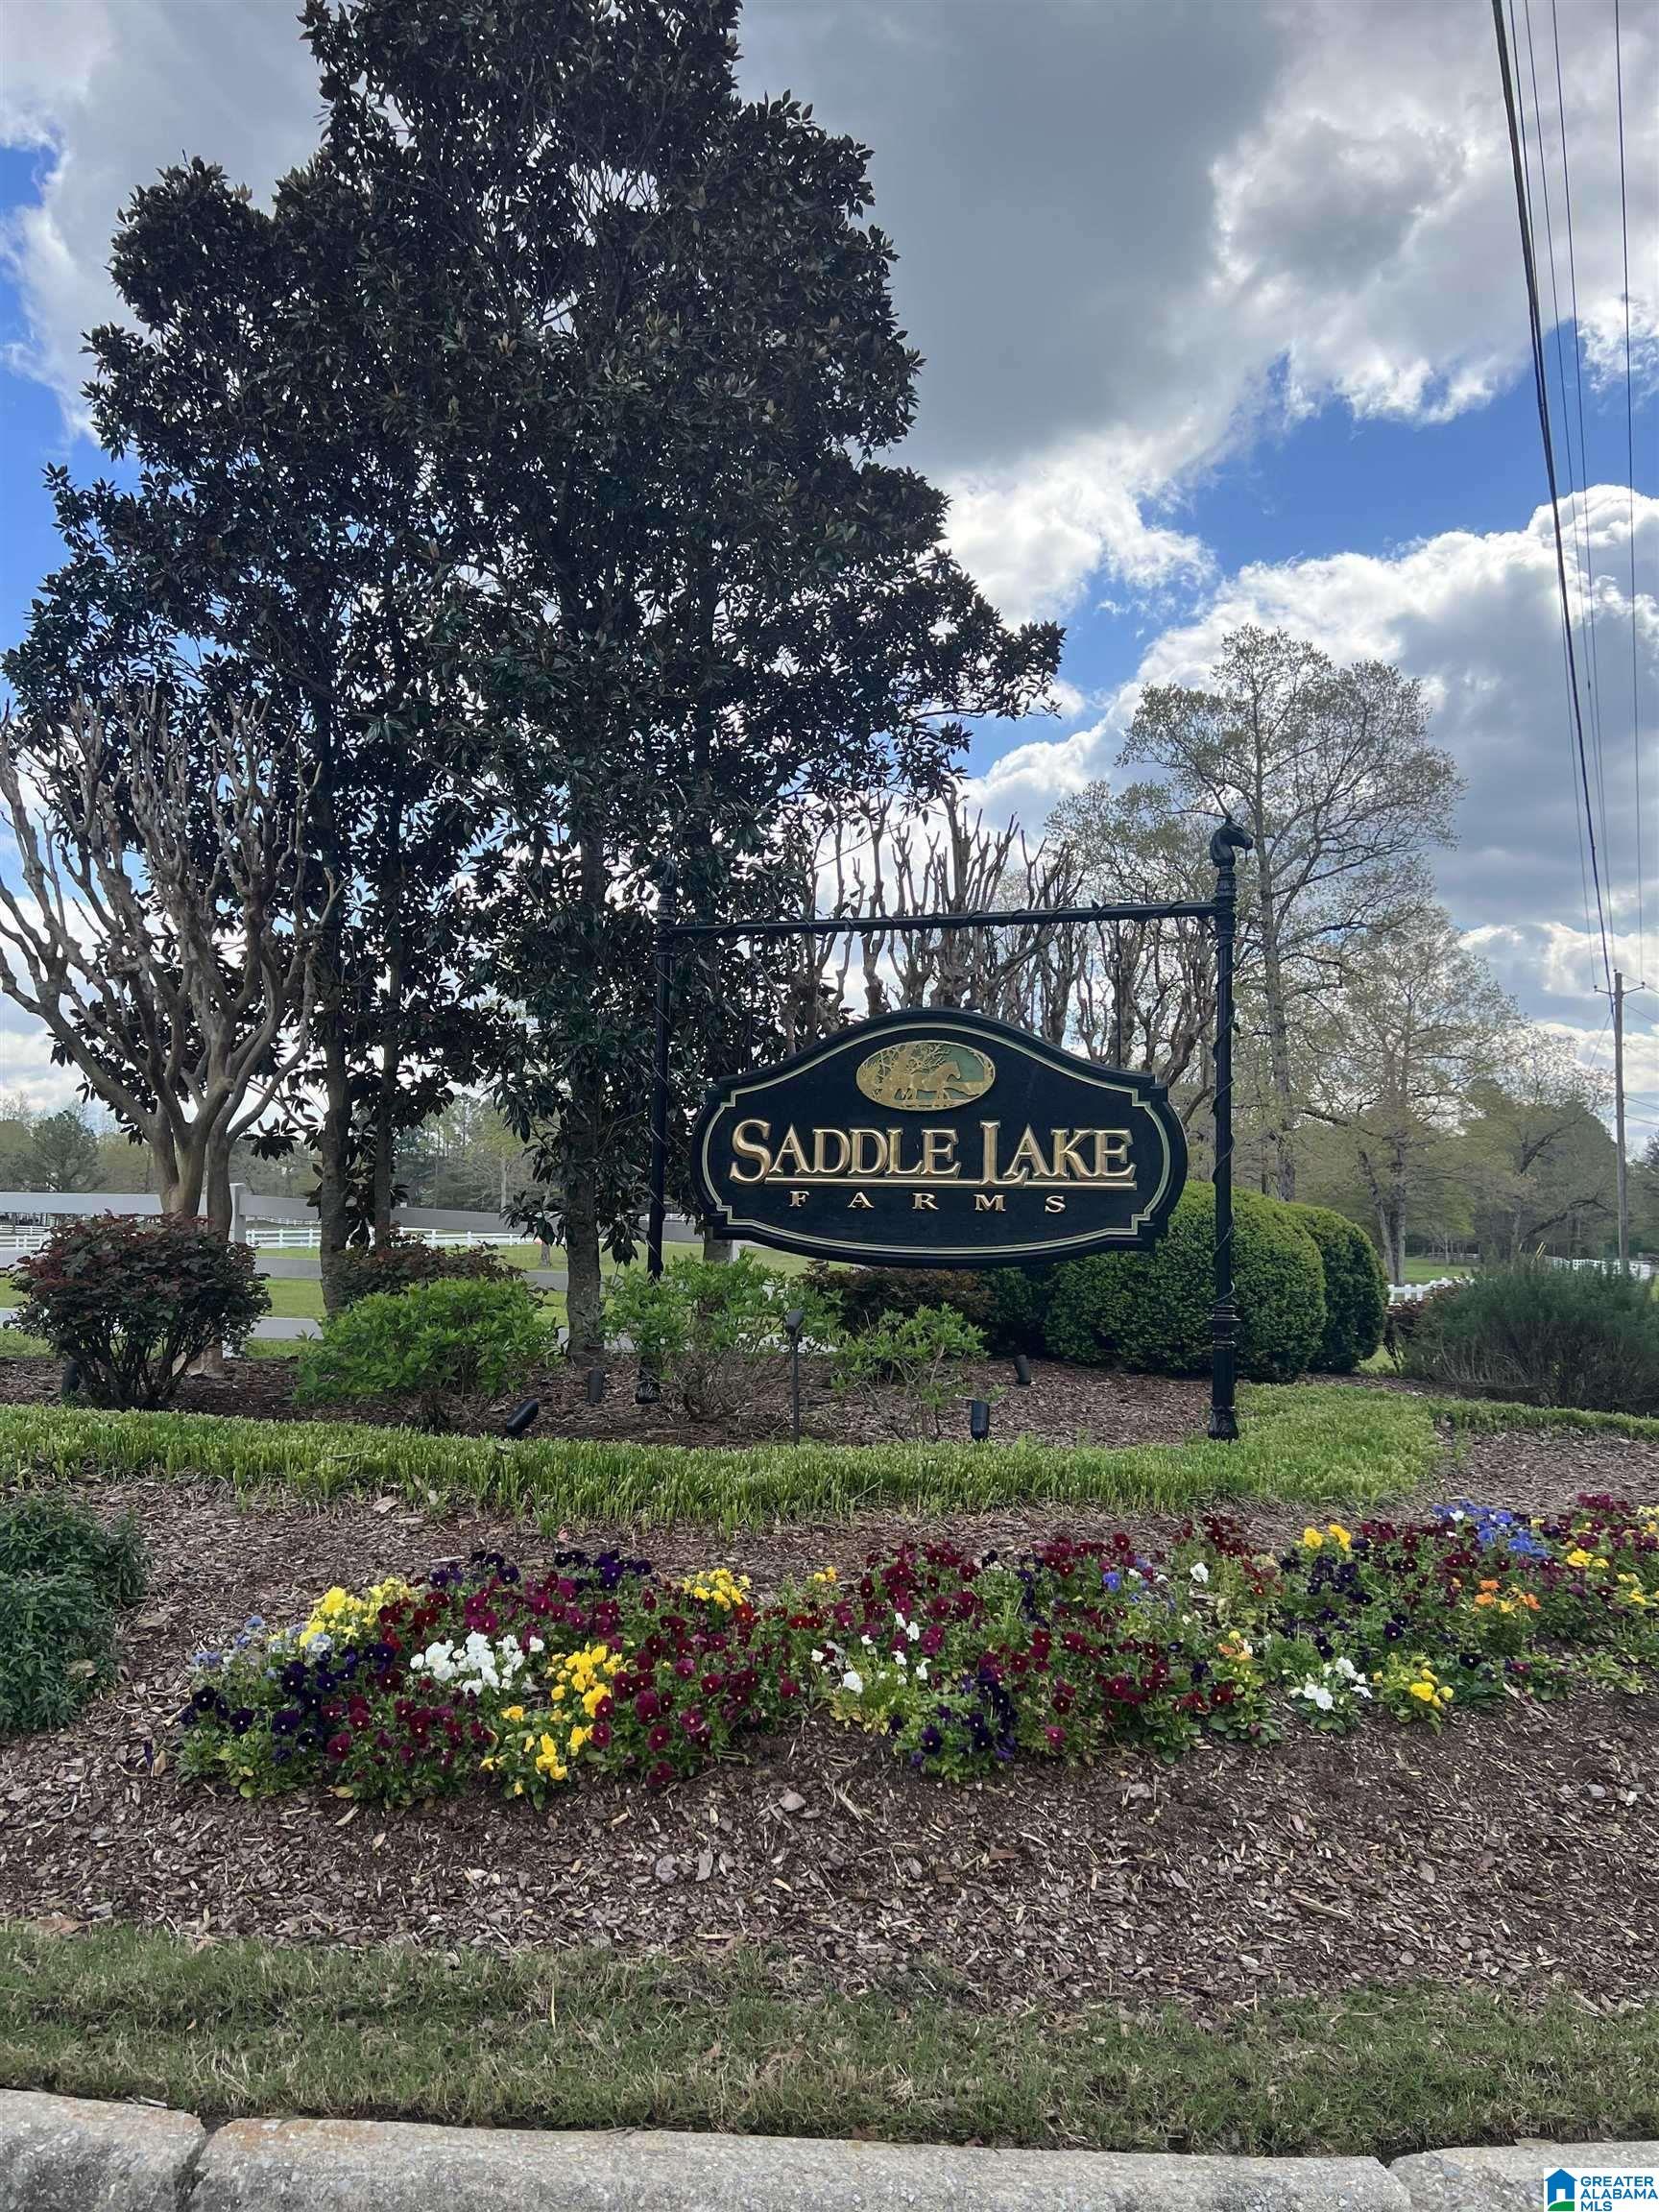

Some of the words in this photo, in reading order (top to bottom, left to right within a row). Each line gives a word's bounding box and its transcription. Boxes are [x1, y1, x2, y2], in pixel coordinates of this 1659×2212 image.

[730, 1118, 961, 1185] SADDLE
[979, 1120, 1136, 1187] LAKE
[789, 1190, 1067, 1214] FARMS
